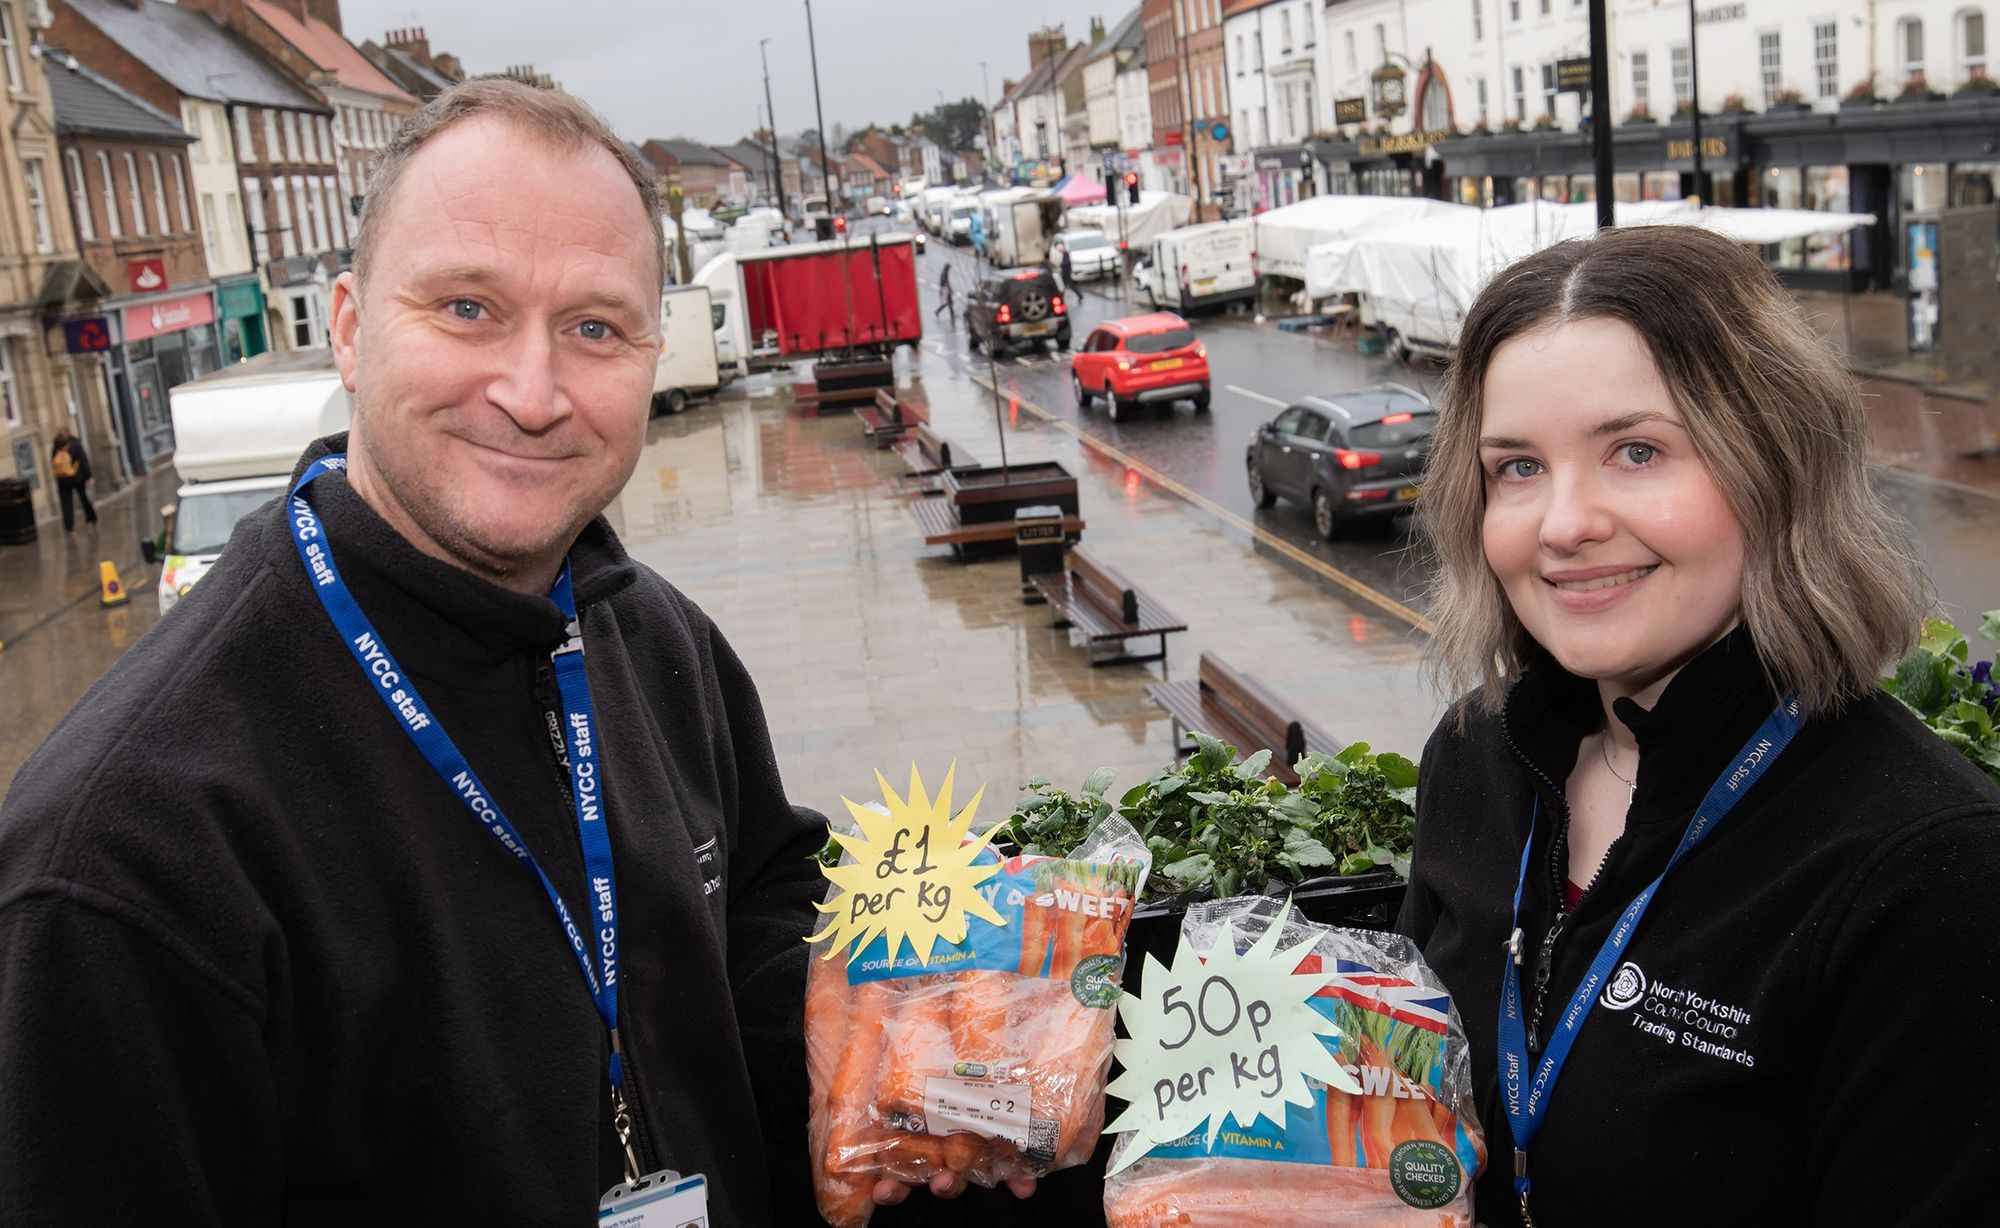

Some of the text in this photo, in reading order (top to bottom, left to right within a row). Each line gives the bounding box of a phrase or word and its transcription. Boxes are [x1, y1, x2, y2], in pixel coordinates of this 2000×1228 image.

[293, 495, 336, 586] NYCC staff
[354, 632, 431, 731] NYCC staff
[545, 710, 571, 767] GRIZZLY
[1726, 738, 1773, 792] NYCC Staff
[569, 712, 599, 821] NYCC staff
[452, 771, 527, 857] NYCC staff
[876, 825, 938, 879] £1
[556, 897, 584, 951] NYCC
[850, 887, 905, 924] per
[1035, 888, 1129, 921] SWEET
[1612, 893, 1648, 948] NYCC Staff
[592, 877, 616, 987] NYCC staff
[967, 950, 977, 959] A
[1159, 975, 1272, 1050] 50p
[1507, 990, 1517, 1020] NYCC
[1564, 974, 1599, 1030] NYCC Staff
[1686, 989, 1751, 1025] Yorkshire
[1632, 1012, 1755, 1067] Trading Standards
[989, 1099, 1015, 1113] C 2
[1153, 1066, 1215, 1121] per
[1506, 1052, 1520, 1116] NYCC Staff
[1528, 1057, 1554, 1116] NYCC Staff
[1161, 1133, 1200, 1147] OURCE
[1221, 1132, 1272, 1147] VITAMIN
[1275, 1140, 1284, 1150] A
[1394, 1142, 1454, 1166] CHOSEN WITH CARE
[1404, 1161, 1445, 1173] QUALITY
[1393, 1168, 1458, 1206] FOR FRESHNESS AND TASTE
[1405, 1172, 1446, 1183] CHECKED
